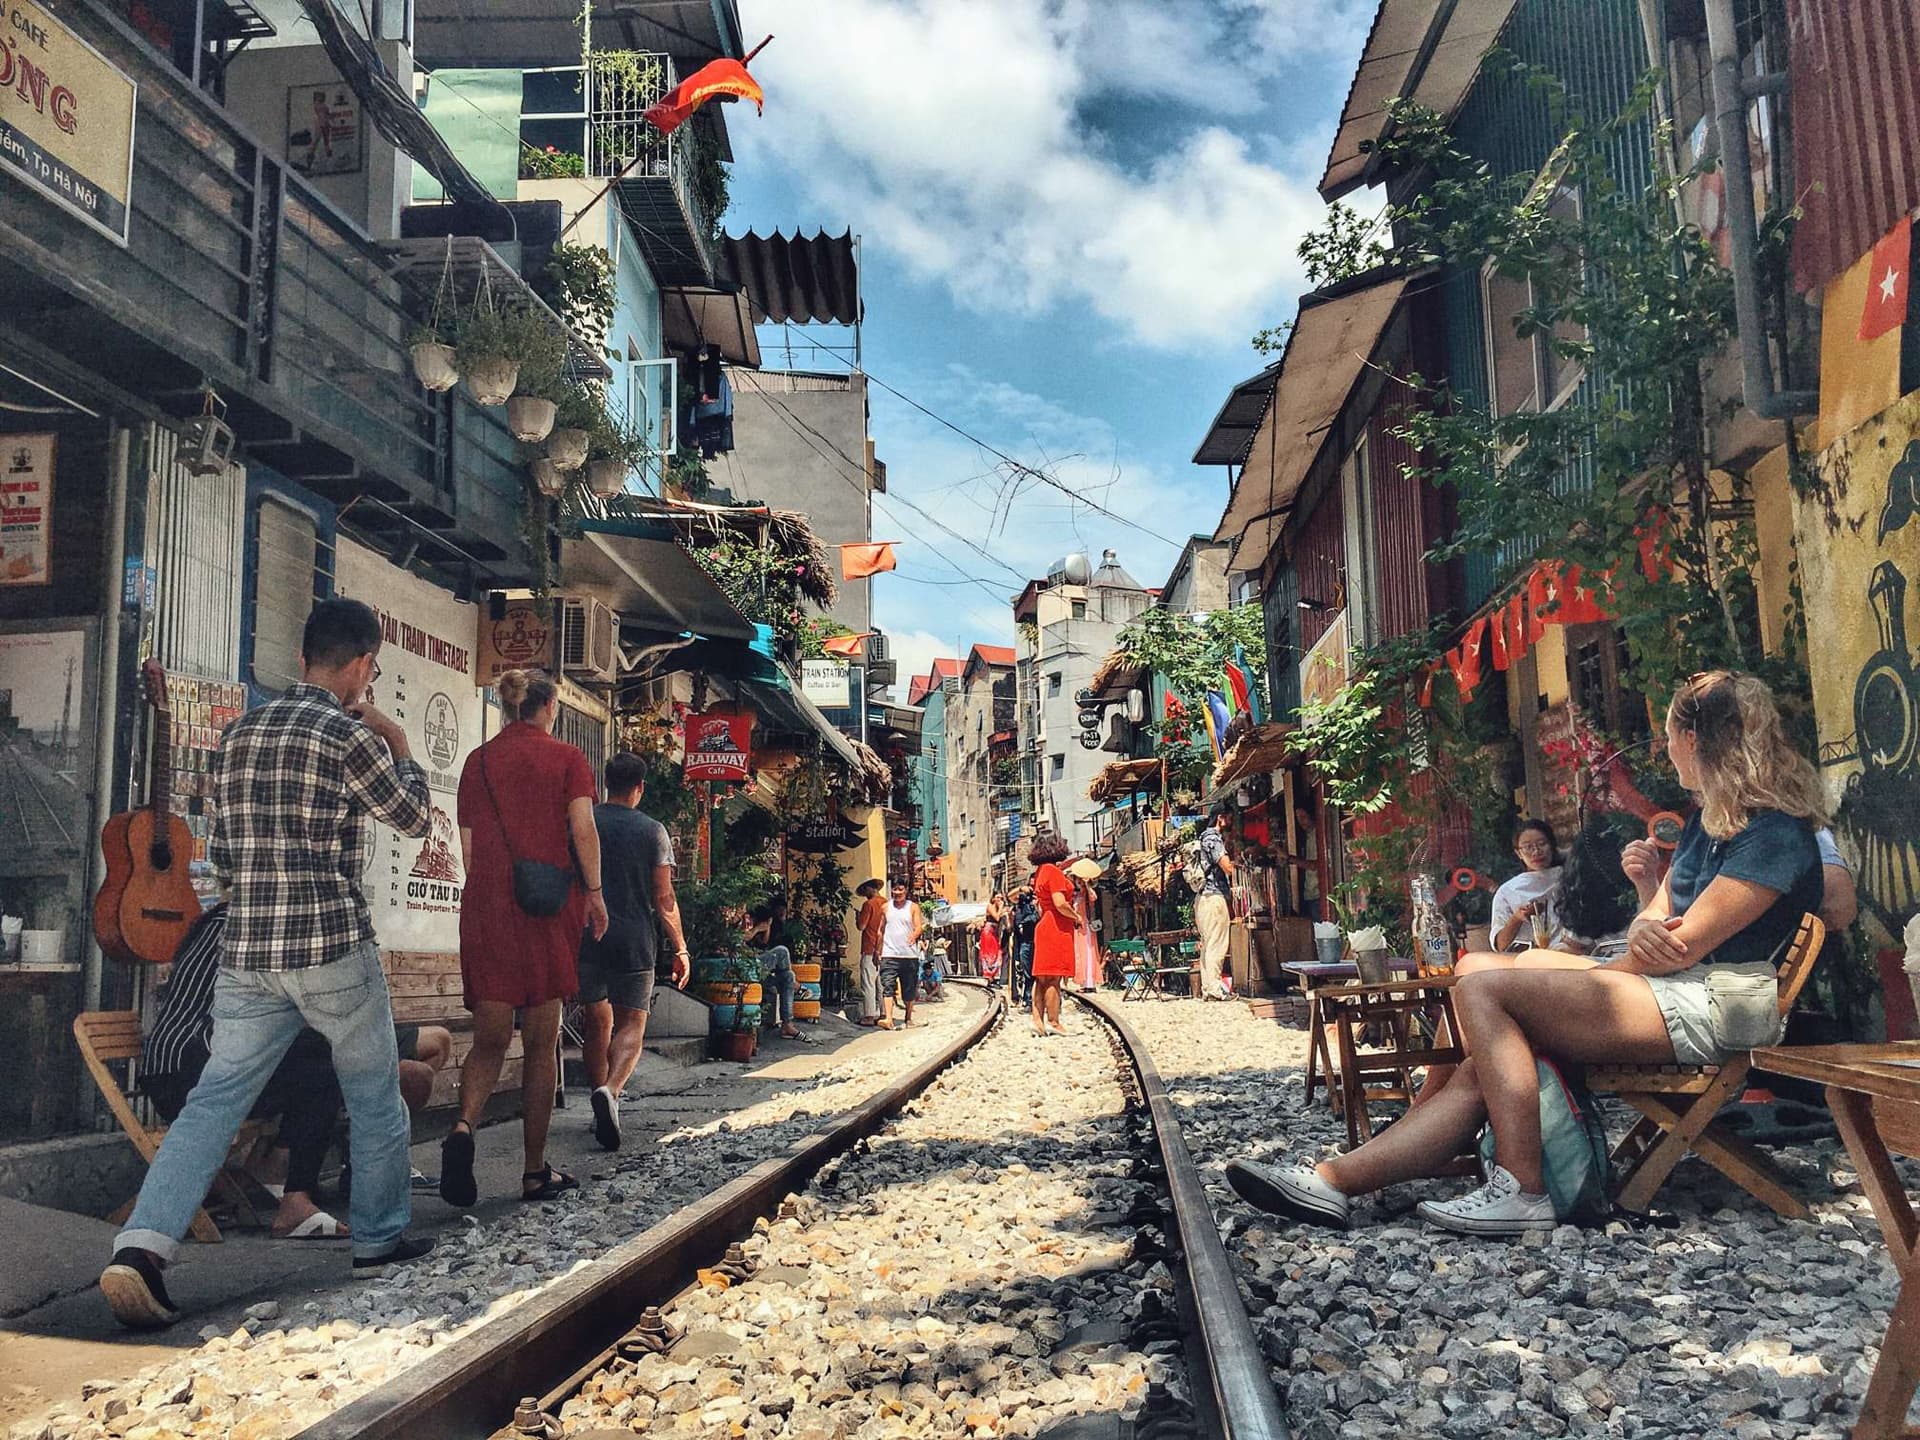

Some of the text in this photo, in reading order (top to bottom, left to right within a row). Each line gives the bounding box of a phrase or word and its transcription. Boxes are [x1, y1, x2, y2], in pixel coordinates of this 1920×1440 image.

[33, 151, 50, 177] Tp
[54, 166, 71, 193] Hà
[75, 181, 97, 209] Nội
[427, 633, 469, 675] TIMETABLE
[802, 667, 850, 679] TRAIN STATION
[686, 752, 747, 768] RAILWAY
[391, 866, 399, 875] Th
[391, 882, 398, 891] Fr
[407, 878, 428, 899] GIỜ
[430, 881, 450, 902] TÀU
[406, 900, 421, 911] Train
[422, 901, 451, 914] Departure
[1426, 937, 1448, 951] Tiger
